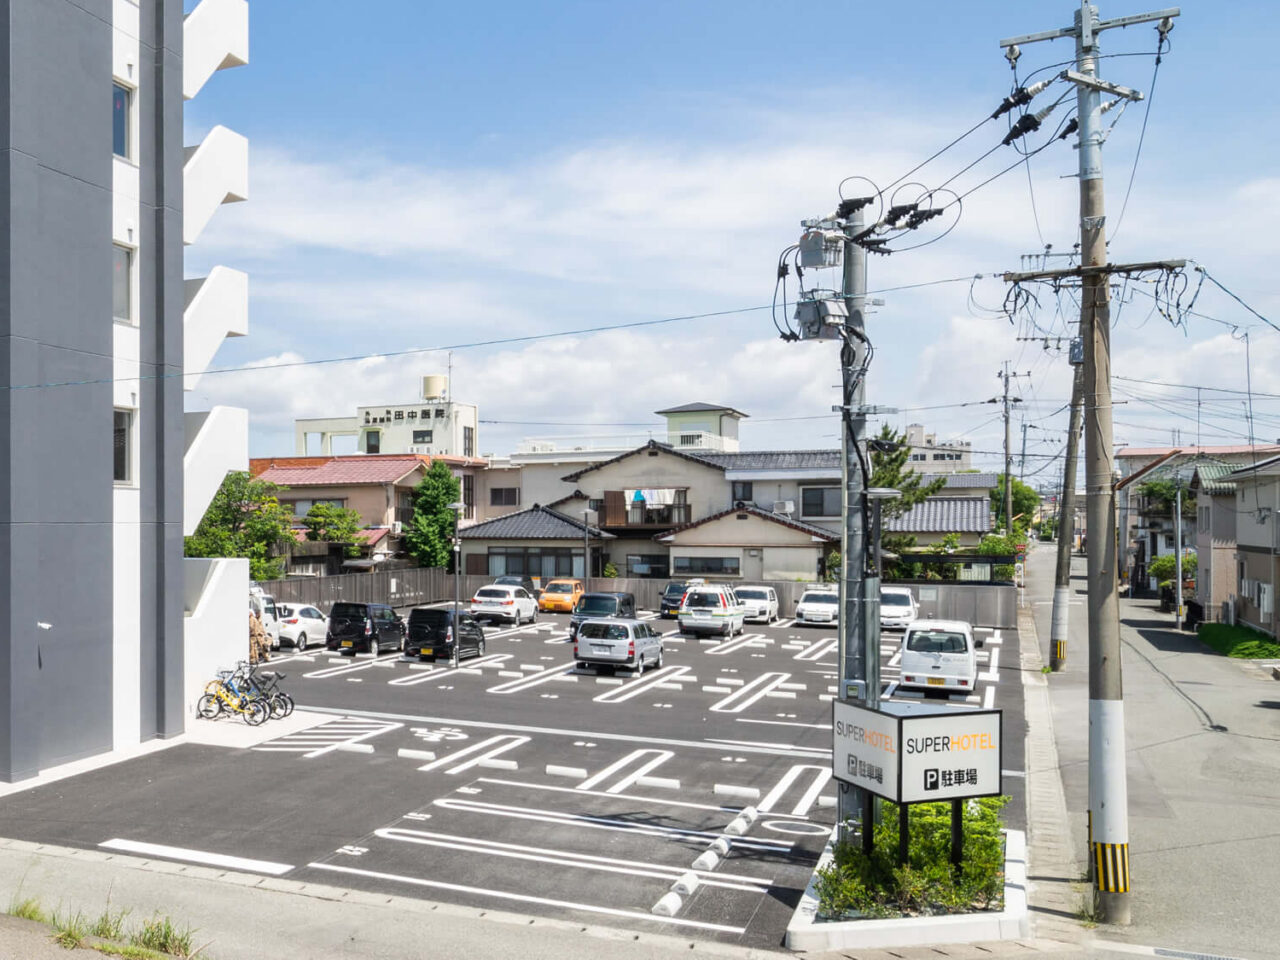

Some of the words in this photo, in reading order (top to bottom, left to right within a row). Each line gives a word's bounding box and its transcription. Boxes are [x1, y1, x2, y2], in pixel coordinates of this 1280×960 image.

[836, 720, 897, 754] SUPERHOTEL
[906, 733, 997, 754] SUPERHOTEL
[858, 760, 884, 785] 駐車場
[941, 768, 978, 787] 駐車場
